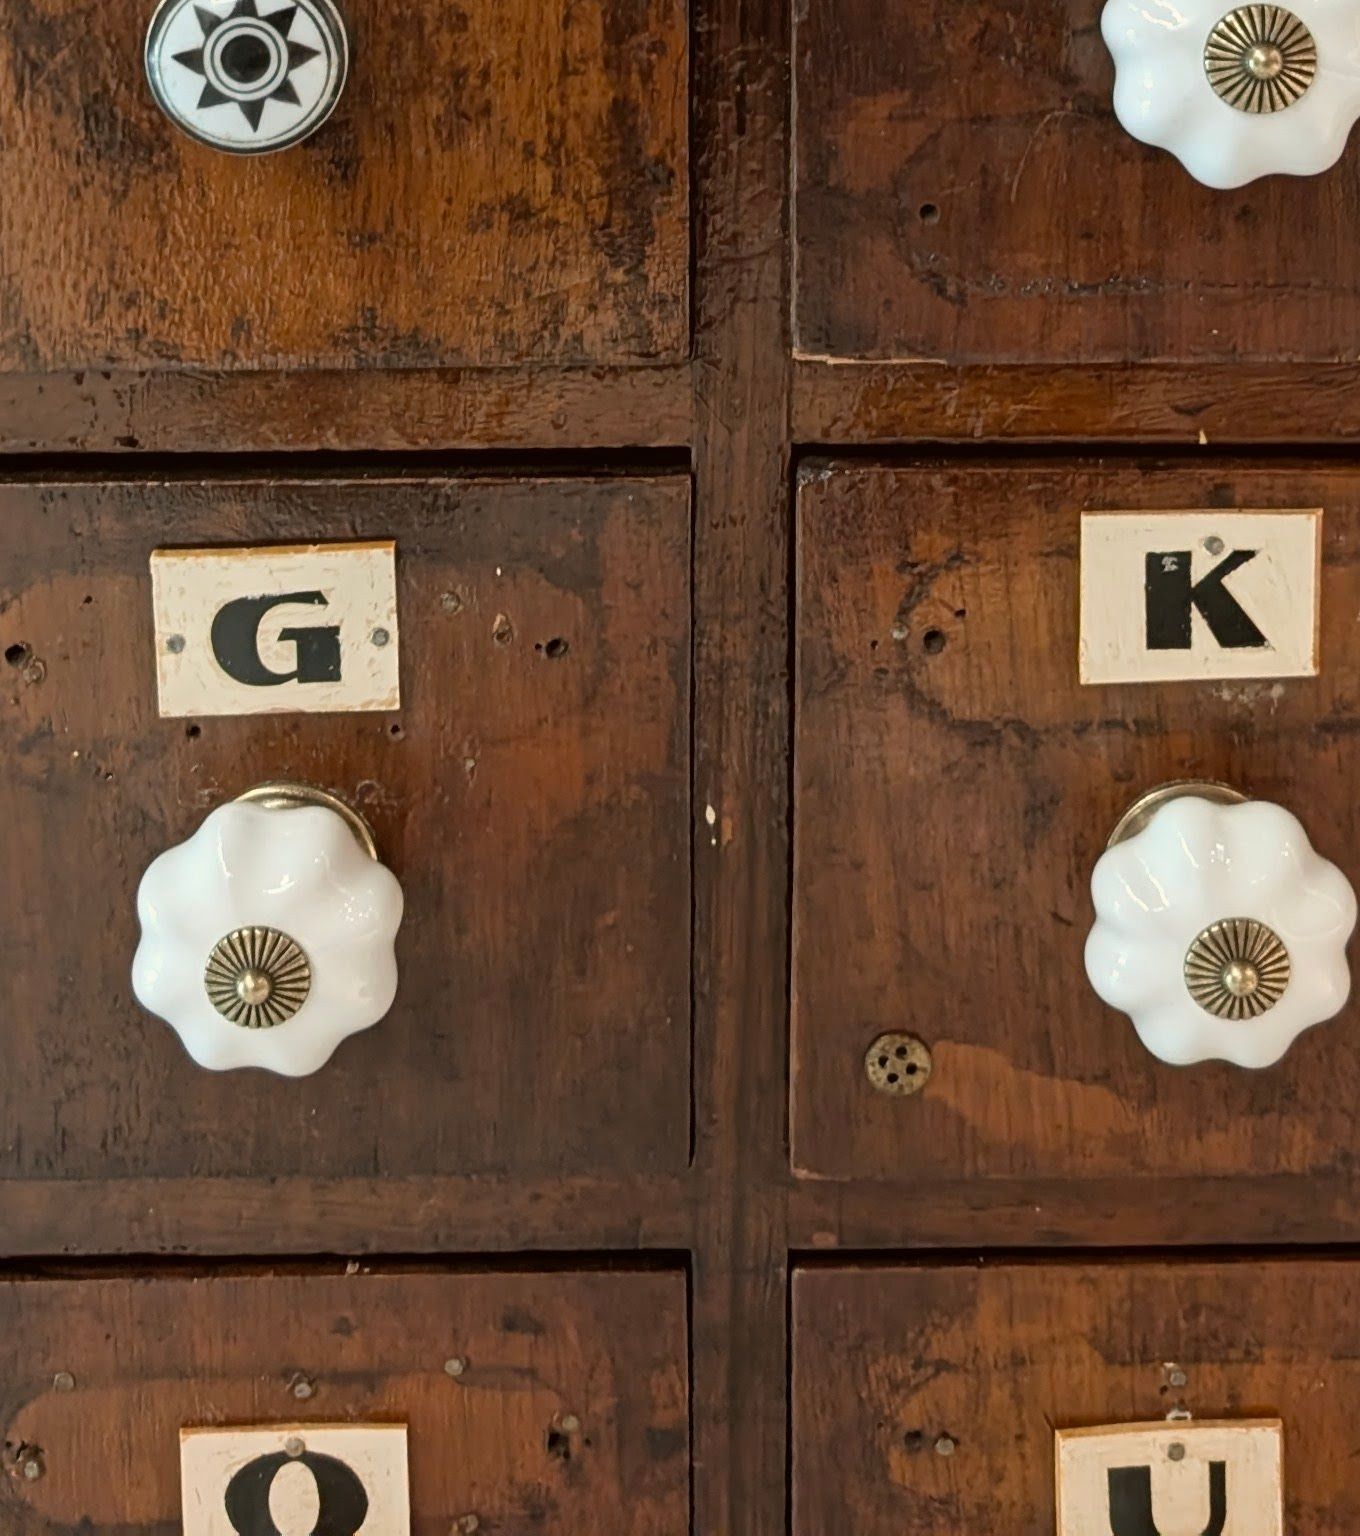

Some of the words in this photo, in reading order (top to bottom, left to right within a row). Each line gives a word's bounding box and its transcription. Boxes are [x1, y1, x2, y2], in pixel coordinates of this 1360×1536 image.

[209, 587, 343, 688] G
[1143, 547, 1268, 651] K
[1106, 1459, 1228, 1536] U
